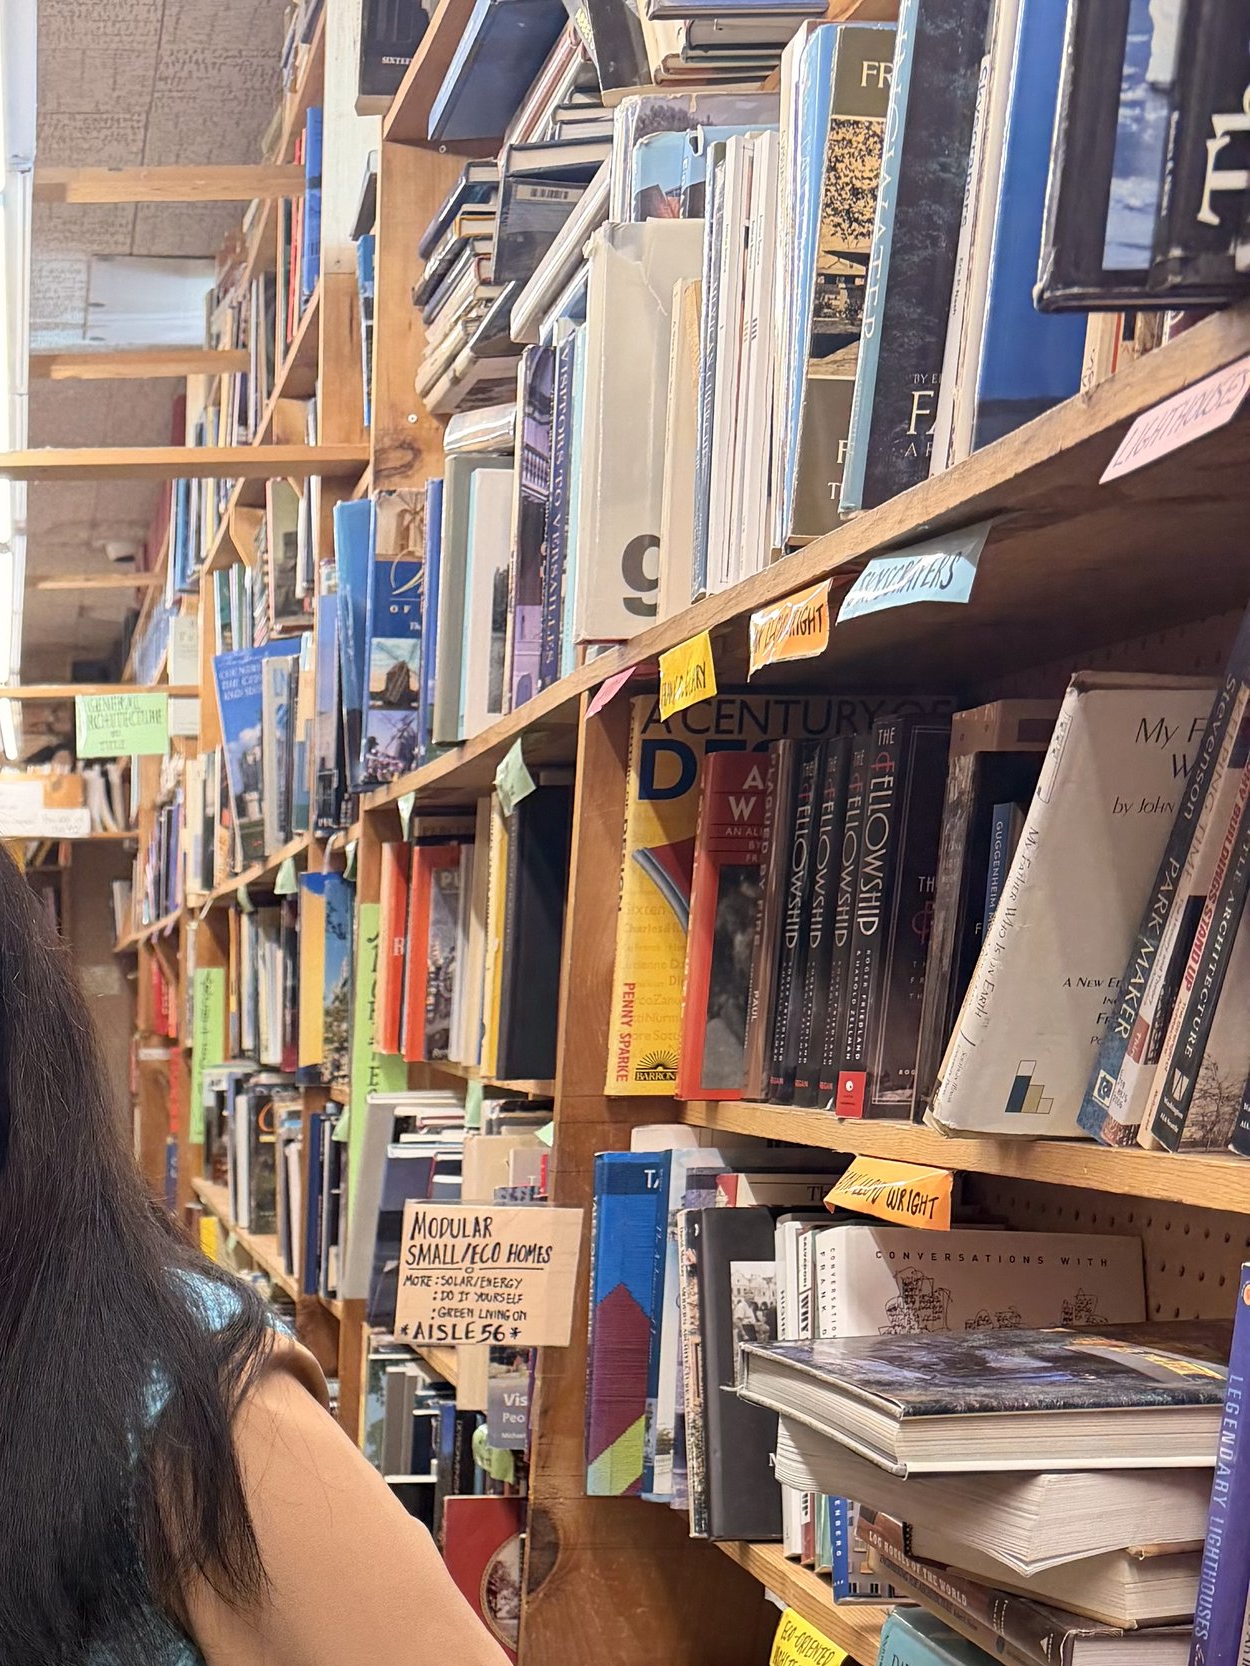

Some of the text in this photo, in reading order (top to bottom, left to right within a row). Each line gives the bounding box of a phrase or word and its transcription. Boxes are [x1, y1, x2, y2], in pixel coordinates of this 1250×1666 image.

[682, 699, 881, 735] CENTURY
[1135, 717, 1179, 749] My
[1113, 798, 1132, 815] by
[857, 728, 895, 936] THE FELLOWSHIP
[810, 779, 835, 948] FELLOWSHIP
[835, 773, 863, 947] FELLOWSHIP
[989, 821, 1004, 908] GUGGENHEIM
[1115, 857, 1181, 1040] PARK MAKER
[1189, 903, 1213, 964] STAND
[1076, 977, 1105, 989] NEW
[1184, 890, 1235, 1059] ARCHITECTURE
[615, 982, 636, 1082] PENNY SPARKE
[846, 1009, 855, 1060] ZELLMAN
[886, 1186, 940, 1220] WRIGHT
[410, 1211, 493, 1241] MODULAR
[405, 1241, 553, 1266] SMALL/ECO HOMES
[876, 1249, 1108, 1267] CONVERSATIONS WITH
[458, 1291, 524, 1304] IT YOURSELF
[818, 1251, 828, 1313] FRANK
[412, 1322, 507, 1344] AISLE 56
[478, 1307, 527, 1321] LIVING ON
[1193, 1373, 1244, 1641] LEGENDARY LIGHTHOUSES
[922, 1566, 968, 1607] THE WORLD
